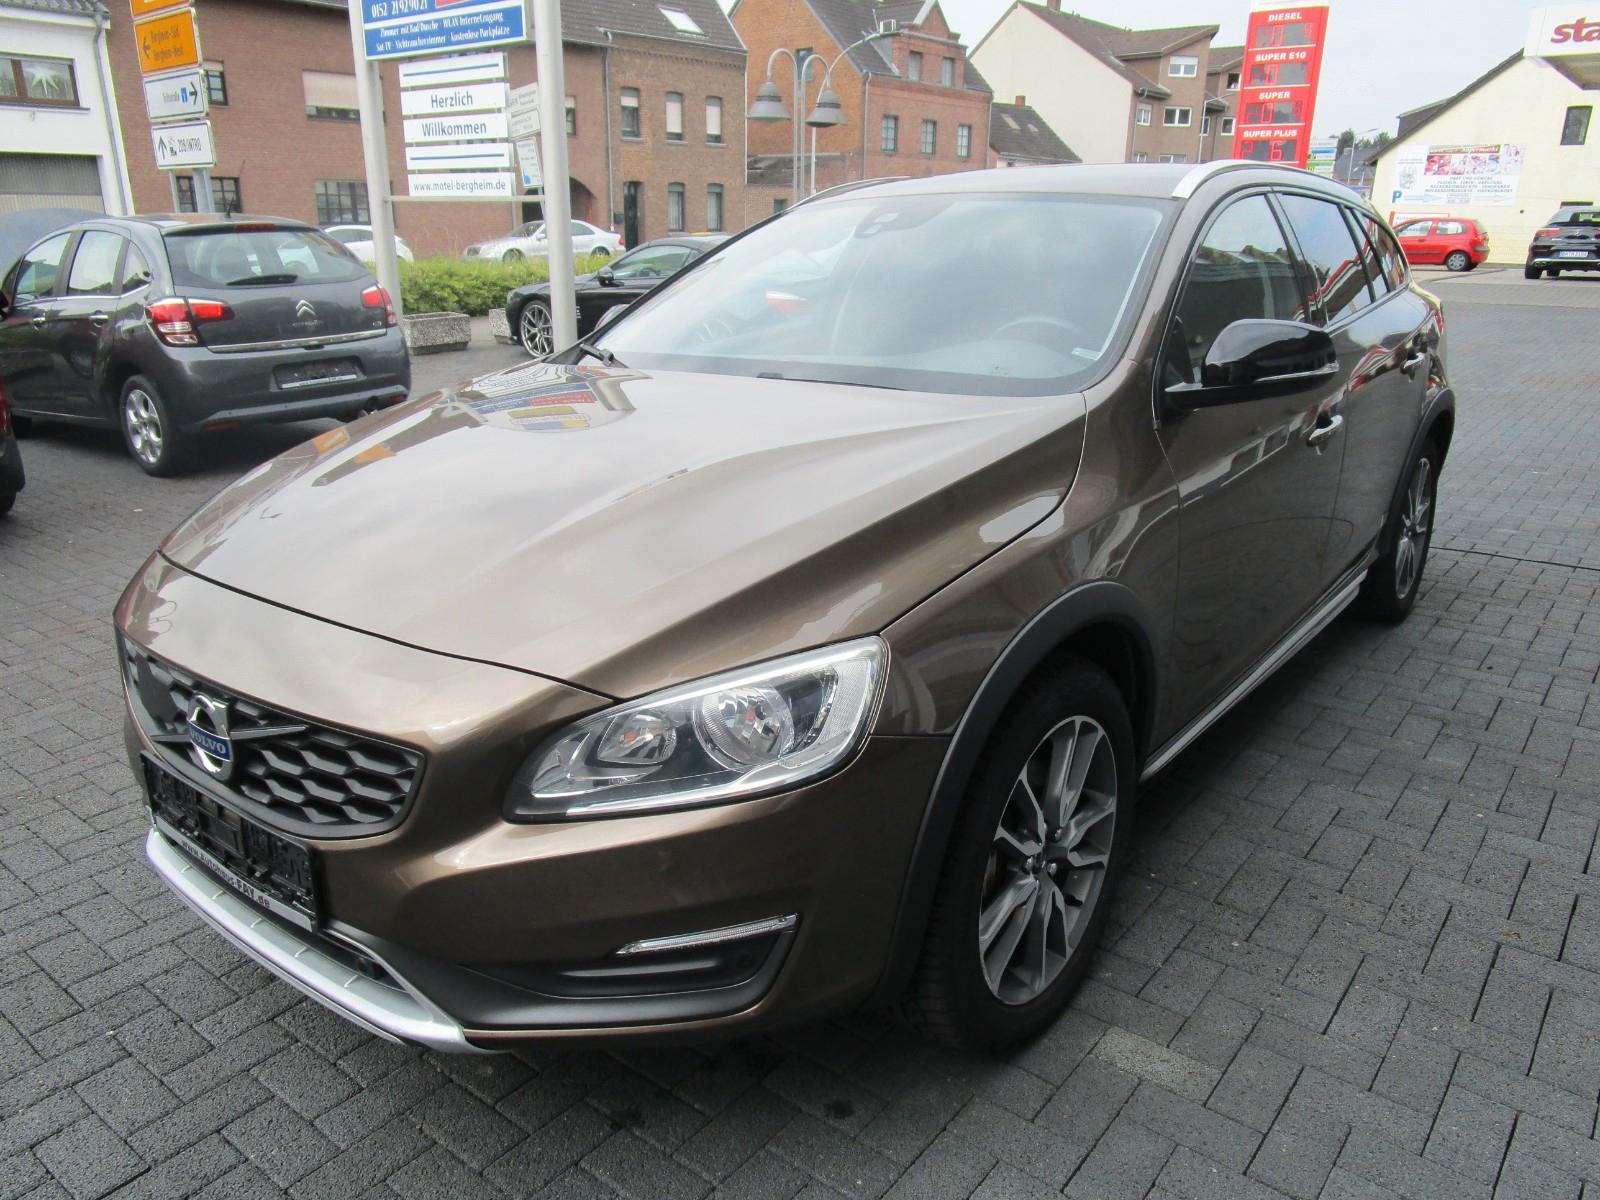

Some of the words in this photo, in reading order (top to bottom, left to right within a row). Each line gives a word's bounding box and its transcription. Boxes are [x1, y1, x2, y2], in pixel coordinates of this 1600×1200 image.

[371, 3, 388, 18] 0152
[1268, 12, 1302, 22] DIESEL
[442, 18, 459, 29] WLAN
[1255, 52, 1286, 62] SUPER
[1289, 51, 1306, 60] E10
[430, 91, 473, 109] Herzlich
[1259, 91, 1290, 100] SUPER
[421, 121, 487, 137] Willkommen
[1243, 129, 1272, 138] SUPER
[1274, 128, 1297, 137] PLUS
[413, 178, 506, 193] www.motel-bergheim.de
[190, 730, 226, 754] VOLVO
